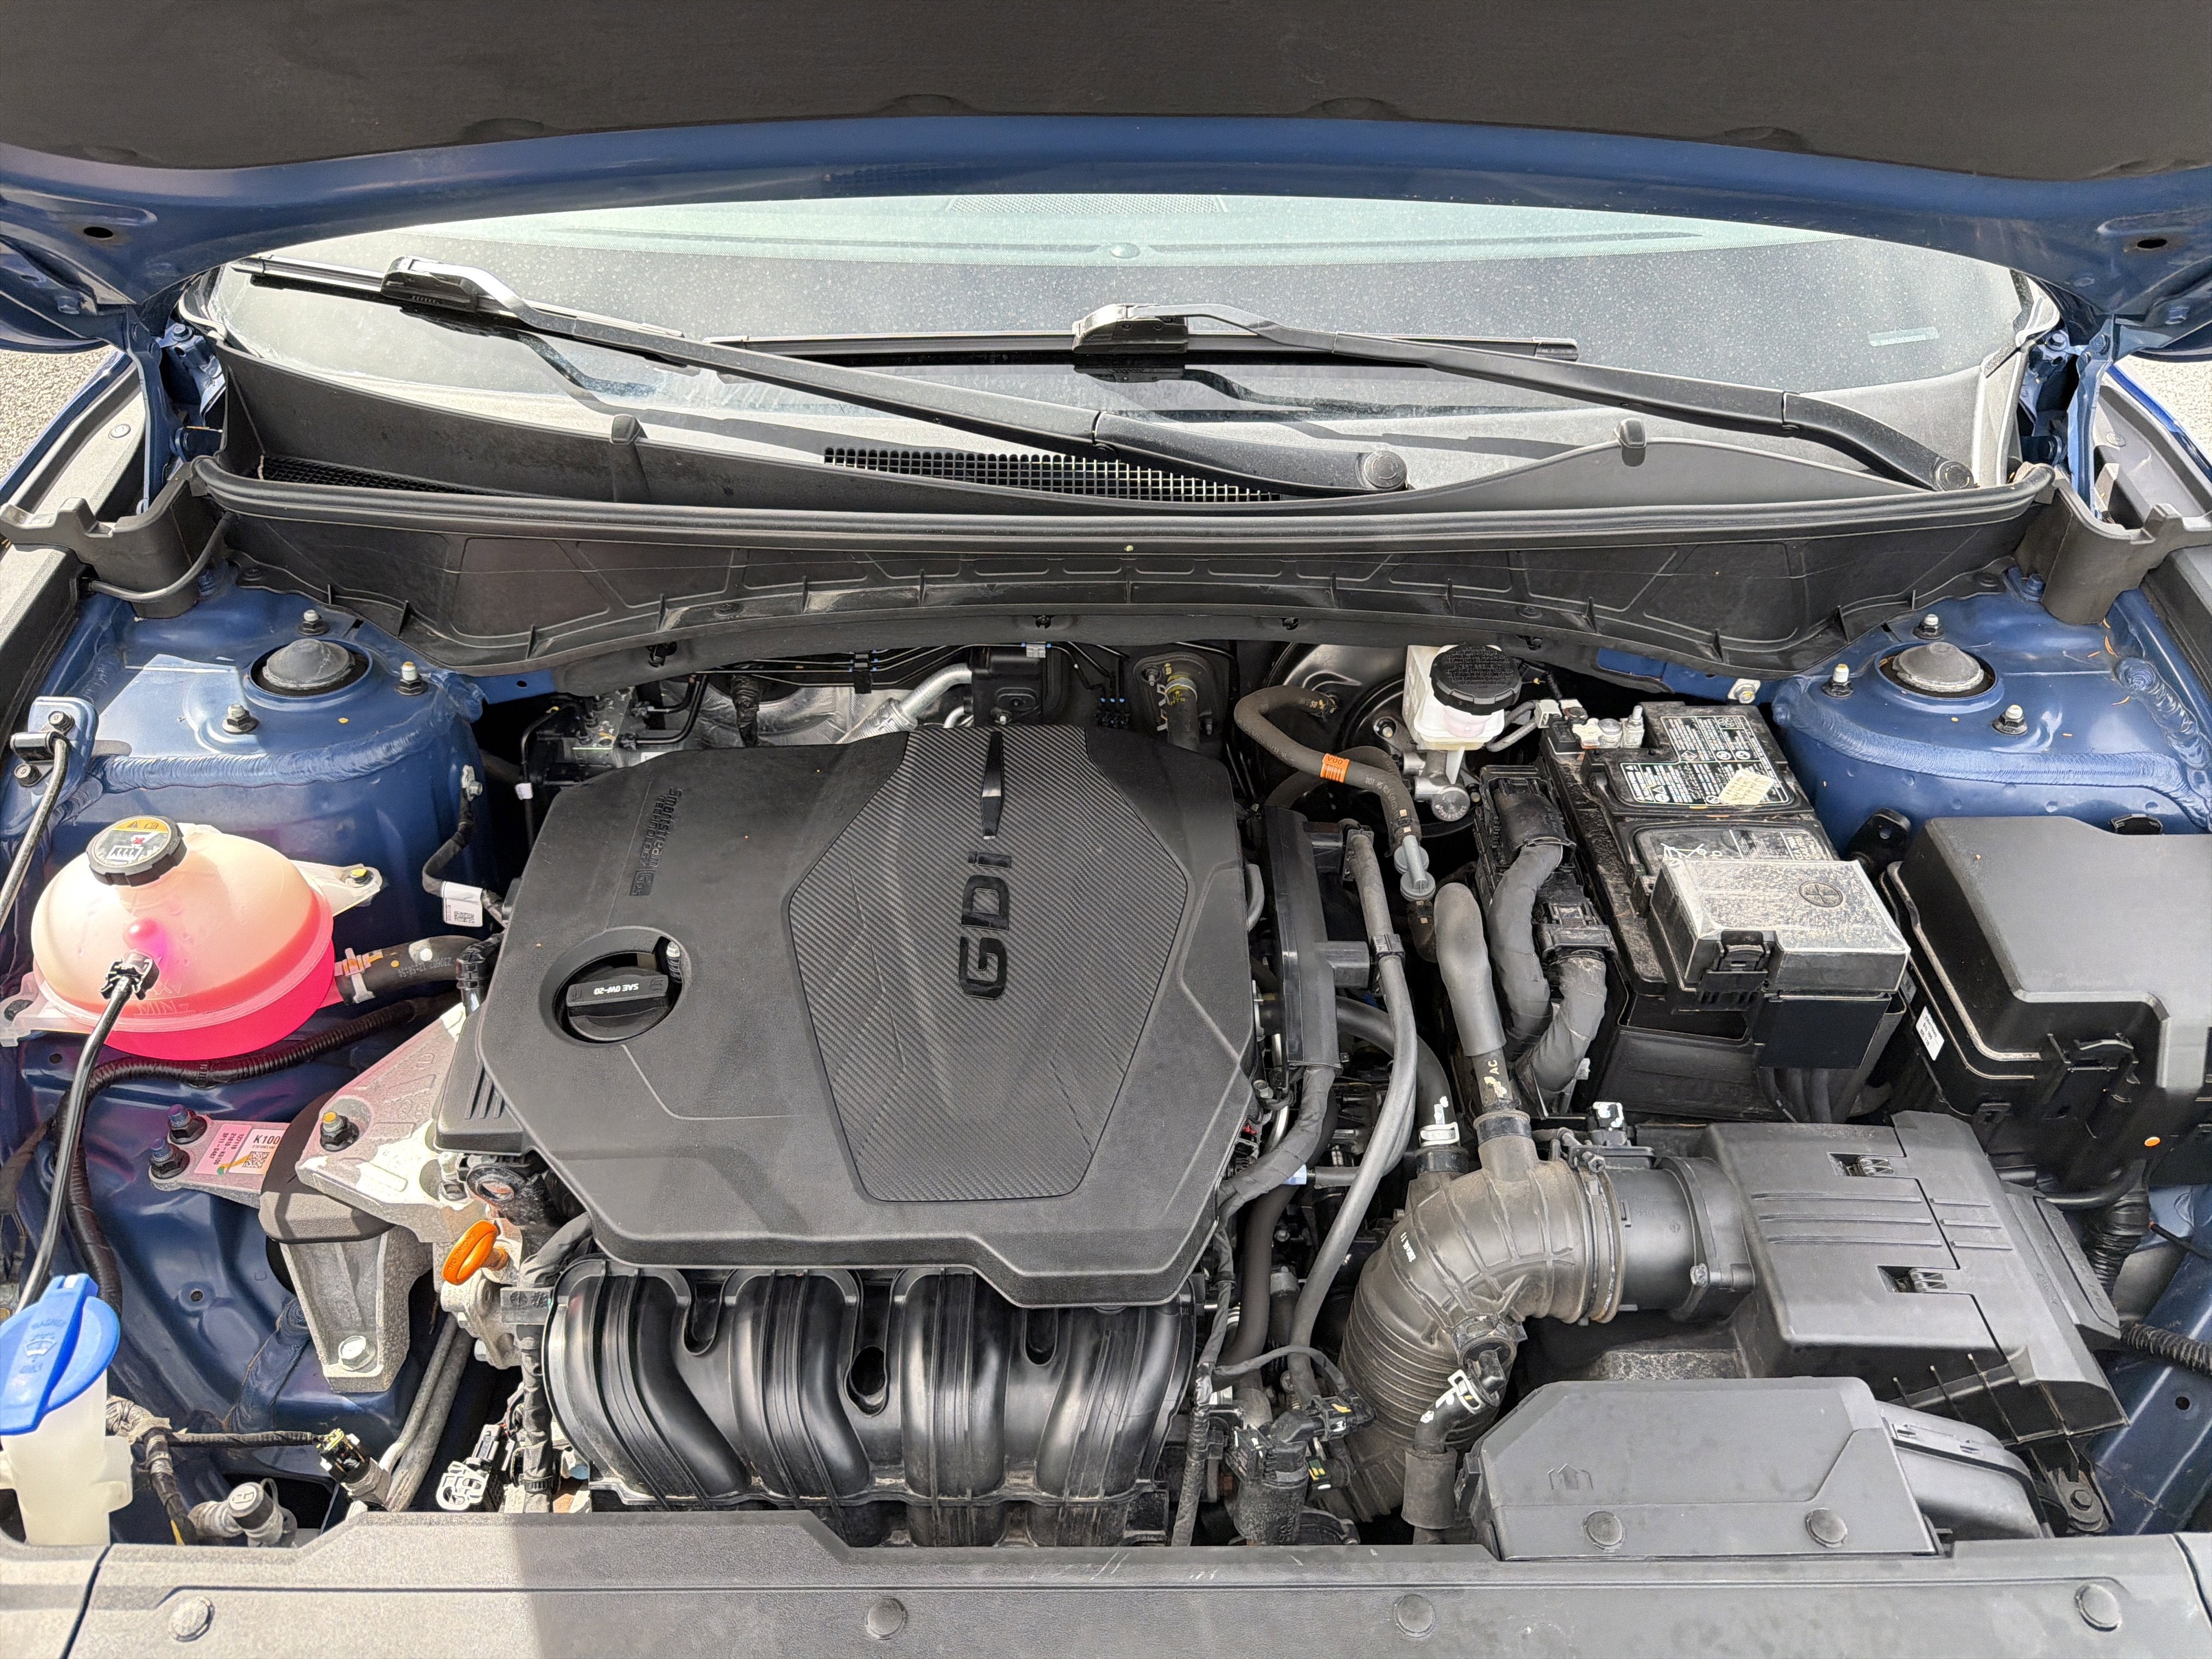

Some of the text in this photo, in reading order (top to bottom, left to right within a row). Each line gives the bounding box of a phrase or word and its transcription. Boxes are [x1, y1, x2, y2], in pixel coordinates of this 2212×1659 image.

[1365, 777, 1375, 786] DOT
[639, 795, 667, 867] TECHNOLOGY
[648, 787, 683, 867] Smartstream
[594, 983, 639, 995] SAE 0W-20
[1488, 1060, 1499, 1074] AC
[231, 1133, 244, 1149] 127119
[253, 1135, 281, 1145] K100
[447, 1231, 477, 1272] ENGINE OIL
